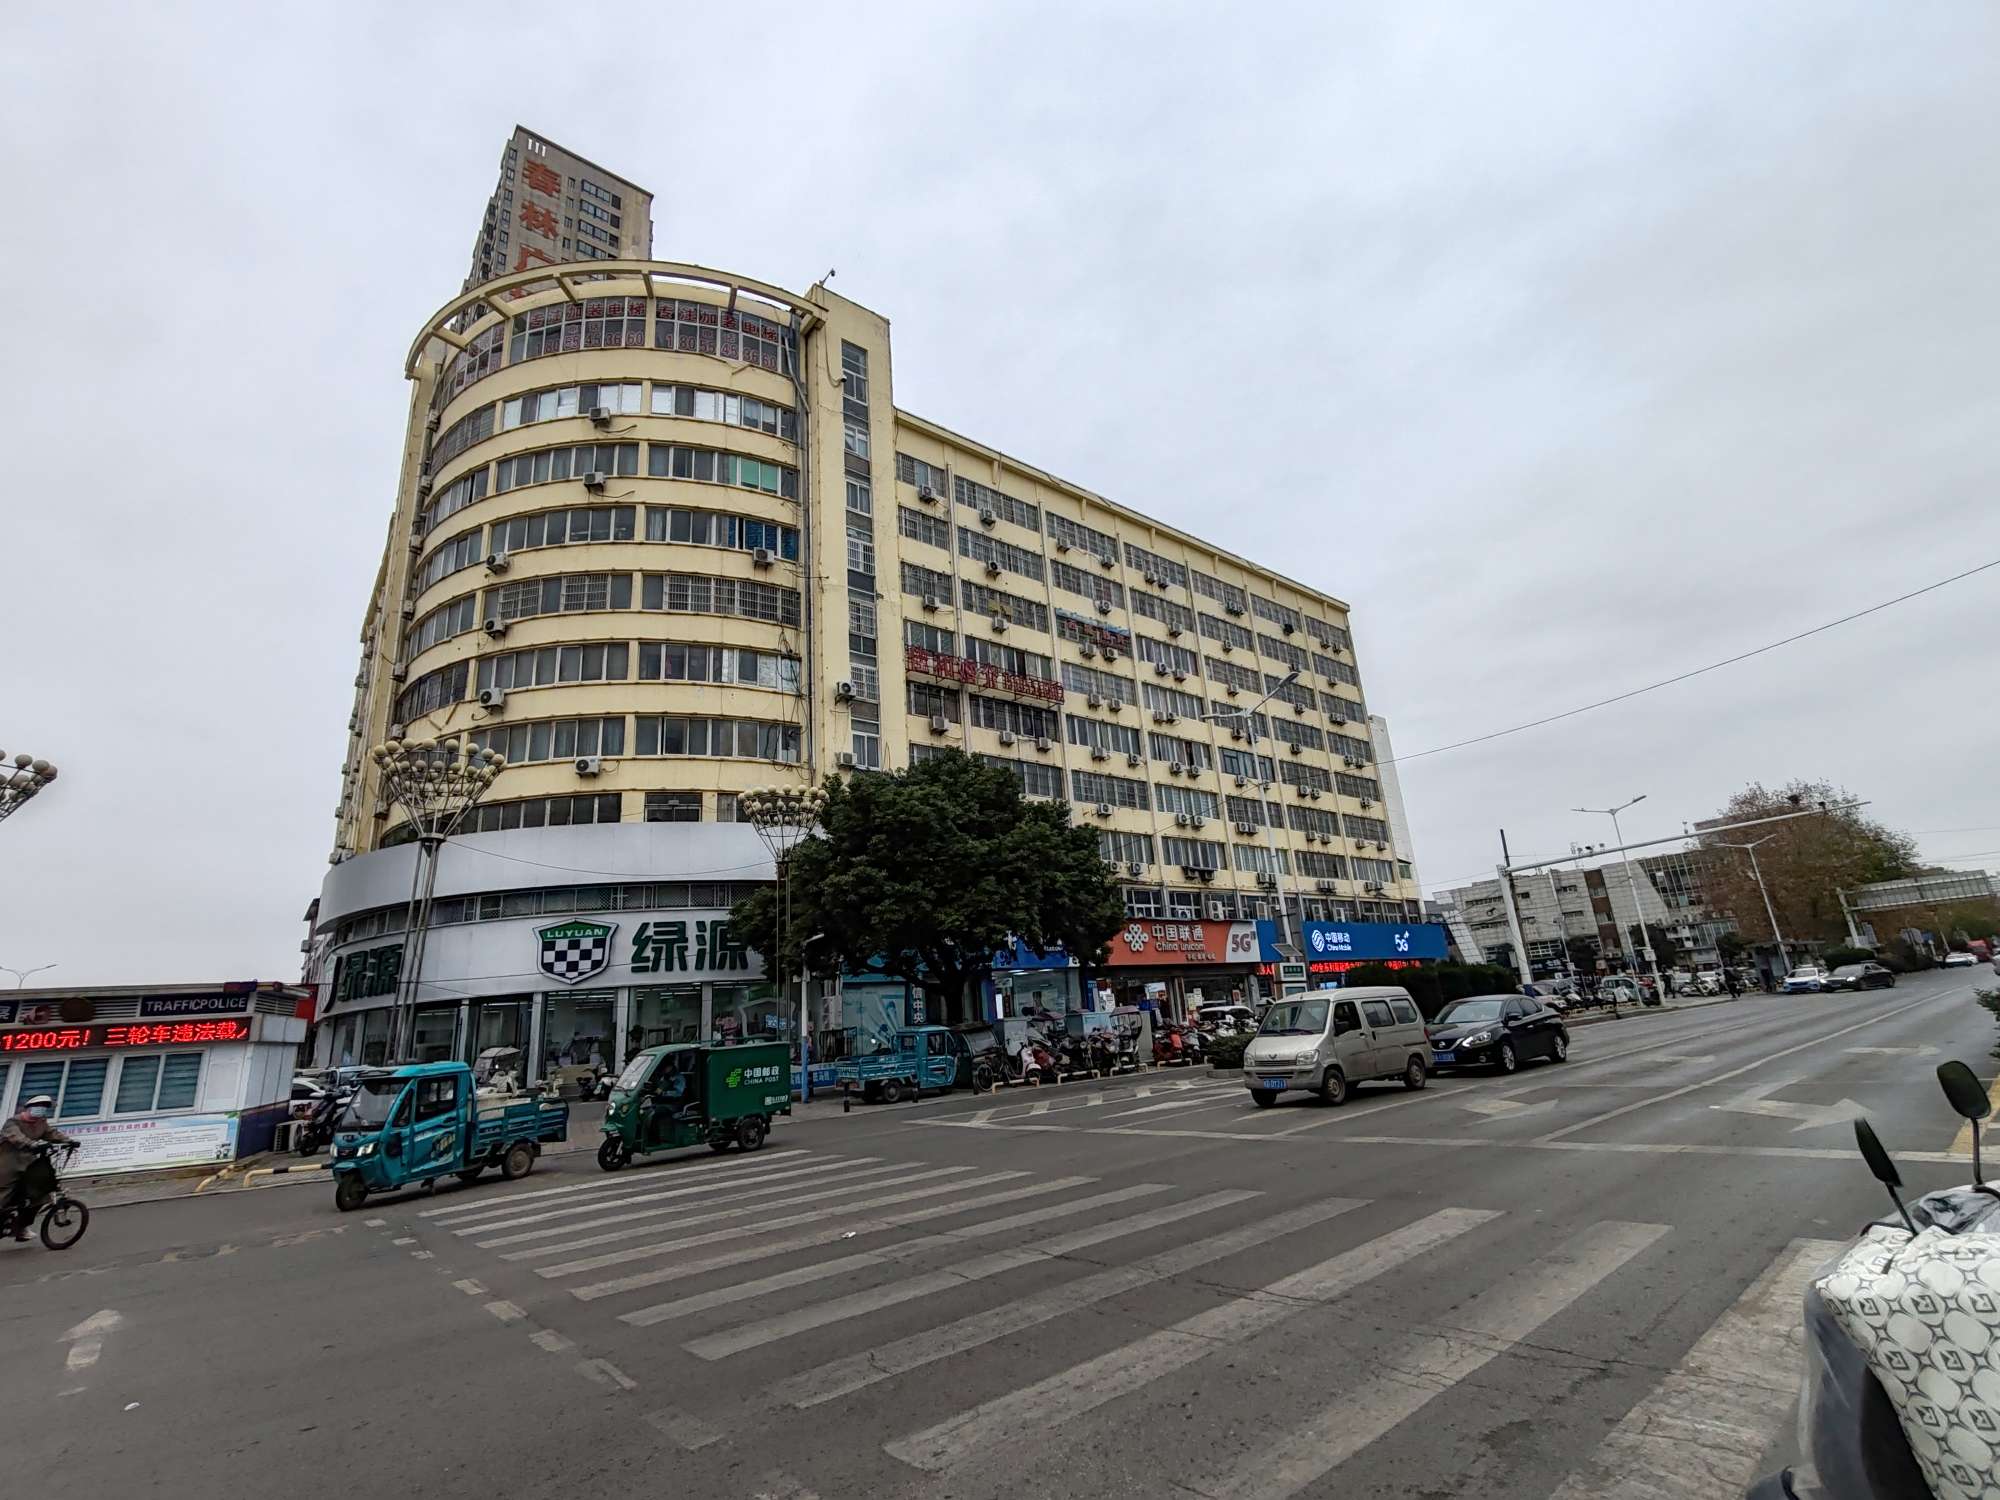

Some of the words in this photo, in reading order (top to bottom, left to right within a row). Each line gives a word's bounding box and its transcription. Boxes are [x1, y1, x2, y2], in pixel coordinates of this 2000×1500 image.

[511, 160, 561, 299] 春林广
[659, 304, 777, 342] 专注加装电梯
[547, 928, 603, 938] LUYUAN
[1152, 924, 1206, 941] 中国联通
[1325, 932, 1351, 943] 中国移动
[631, 920, 748, 973] 绿源
[1156, 942, 1178, 951] China
[744, 1065, 779, 1078] 中国邮政
[744, 1078, 763, 1086] CHINA
[764, 1075, 779, 1083] POST
